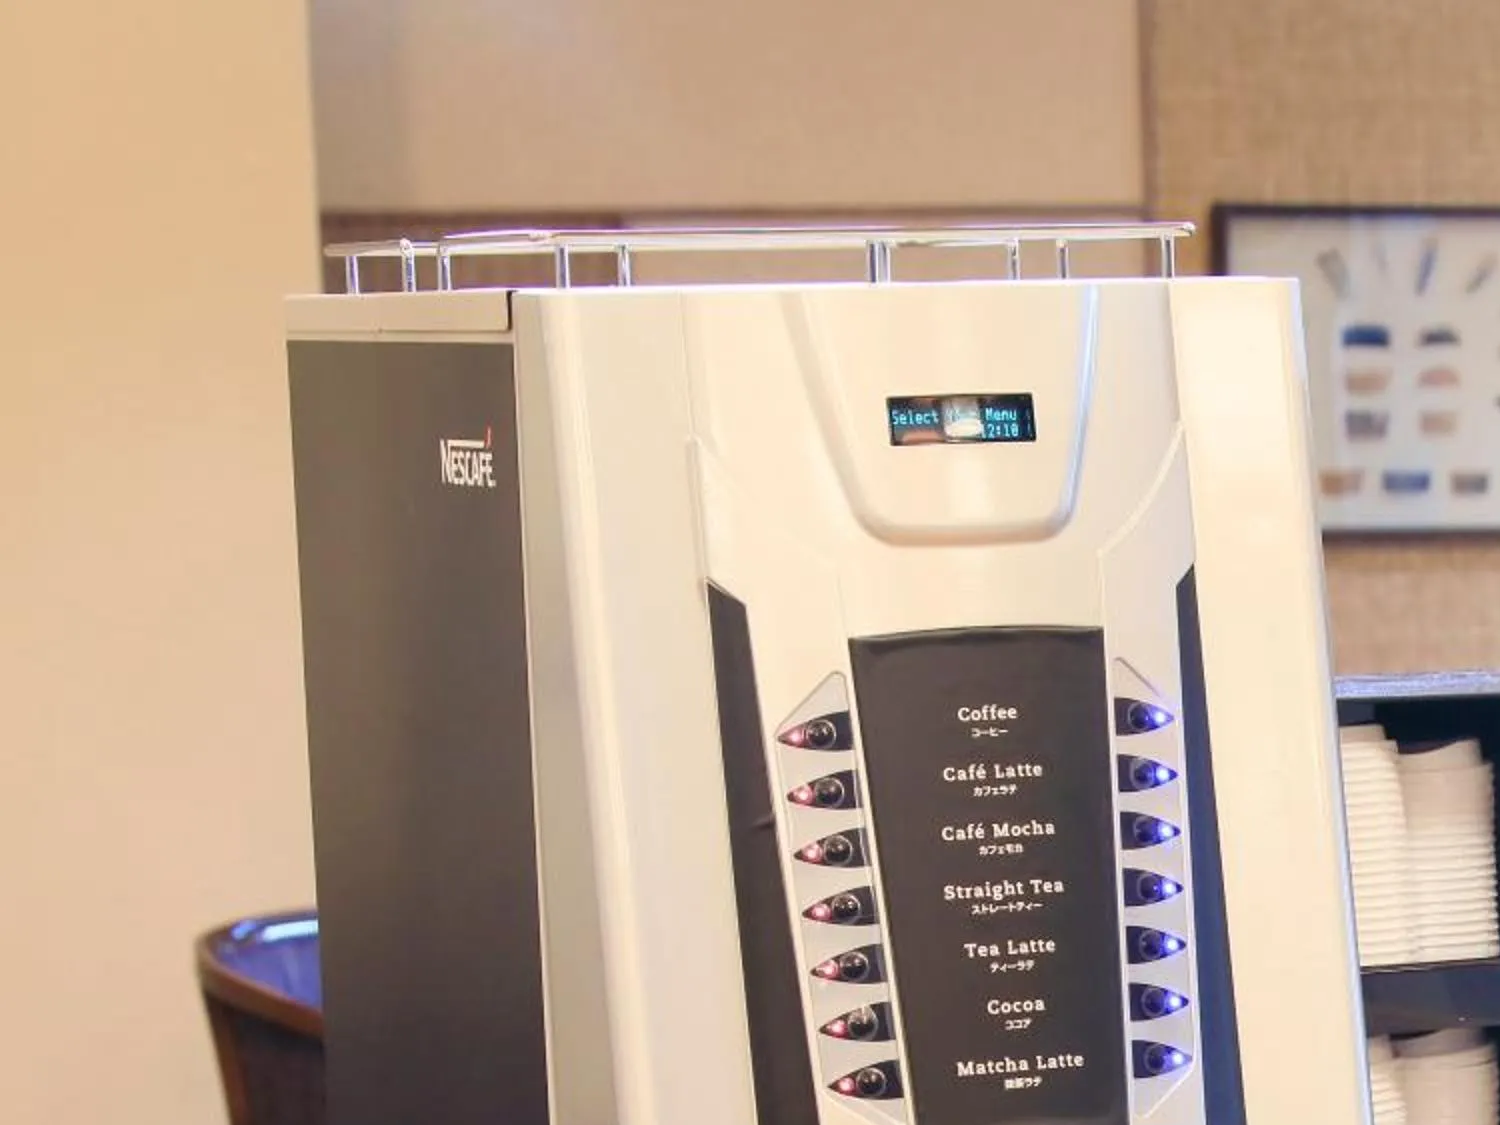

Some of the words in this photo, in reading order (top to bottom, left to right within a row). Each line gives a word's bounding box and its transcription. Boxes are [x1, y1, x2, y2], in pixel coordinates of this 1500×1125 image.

[892, 409, 939, 426] Select
[985, 407, 1018, 422] Menu
[957, 704, 1018, 722] Coffee
[971, 726, 1009, 738] コーヒー
[943, 764, 987, 782] Café
[994, 763, 1043, 779] Latte
[941, 824, 985, 842] Café
[992, 820, 1056, 838] Mocha
[943, 878, 1024, 900] Straight
[1030, 878, 1065, 894] Tea
[971, 901, 1043, 915] ストレートティー
[963, 943, 1000, 958] Tea
[1007, 938, 1056, 955] Latte
[989, 959, 1035, 973] ティーラテ
[987, 999, 1045, 1015] Cocoa
[1005, 1018, 1032, 1030] ココア
[956, 1056, 1029, 1077] Matcha
[1036, 1053, 1085, 1070] Latte
